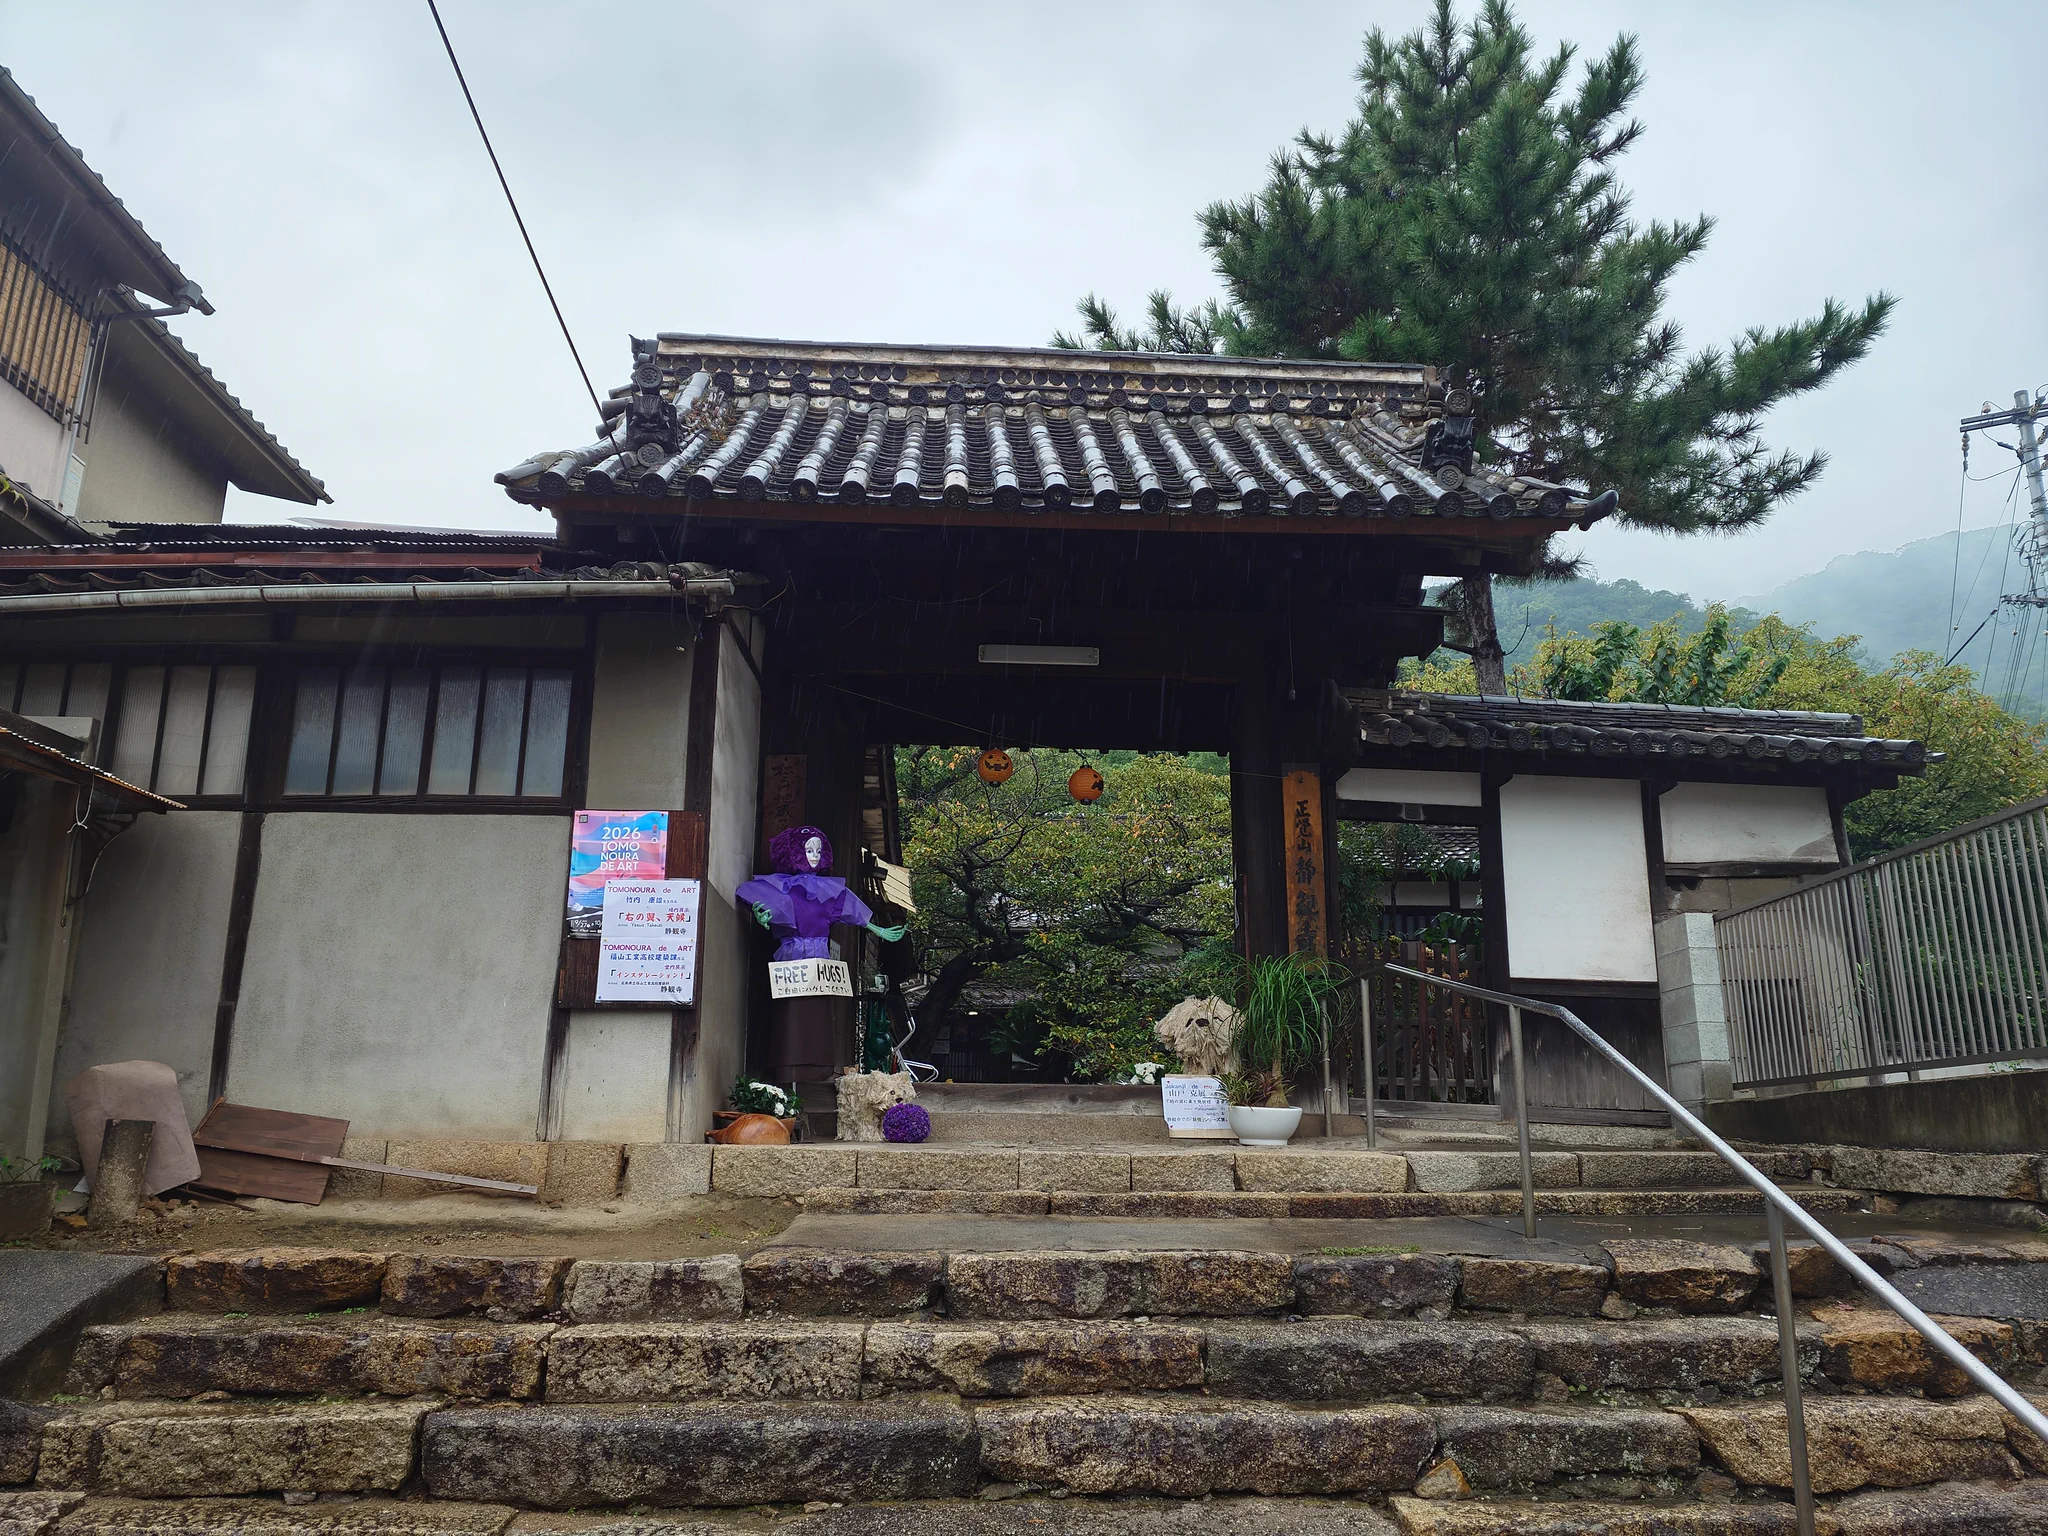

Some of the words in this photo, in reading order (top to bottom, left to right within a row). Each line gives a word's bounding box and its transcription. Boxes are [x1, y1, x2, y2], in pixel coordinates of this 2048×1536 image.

[602, 827, 641, 840] 2026
[602, 841, 640, 851] TOMO
[601, 852, 639, 860] NOURA
[600, 861, 615, 871] DE
[617, 861, 639, 871] ART
[607, 886, 656, 894] TOMONOURA
[626, 896, 641, 904] 竹内
[664, 927, 687, 936] 静観寺
[603, 944, 652, 952] TOMONOURA
[774, 965, 808, 985] FREE
[816, 963, 846, 984] HUGS!
[660, 985, 683, 993] 静観寺
[777, 985, 850, 996] ご自由にハグしてください
